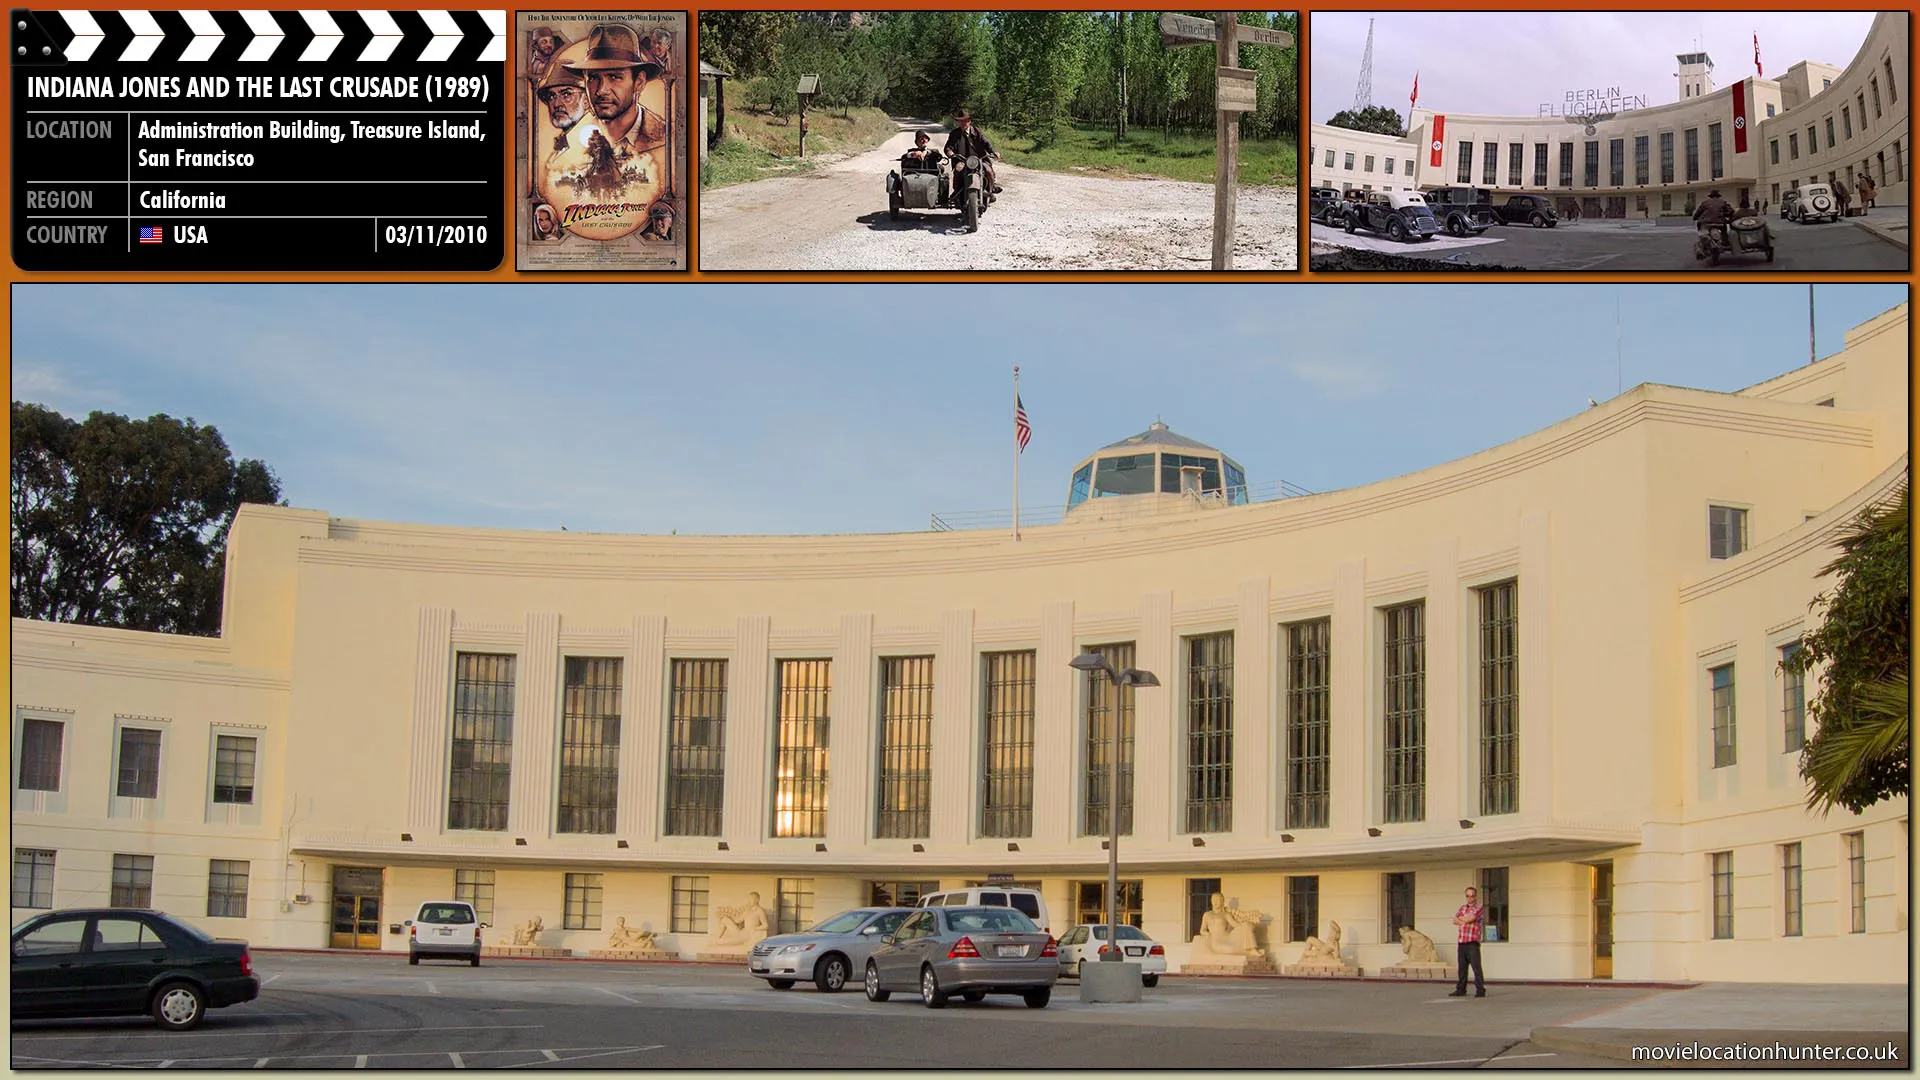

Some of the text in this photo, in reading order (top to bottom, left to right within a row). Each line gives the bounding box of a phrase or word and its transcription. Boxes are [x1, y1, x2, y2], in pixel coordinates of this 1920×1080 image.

[1254, 30, 1280, 43] Berlin
[1566, 86, 1620, 102] BERLIN
[1539, 94, 1646, 118] FLUGHAFEN
[560, 203, 647, 229] INDIANA JONES
